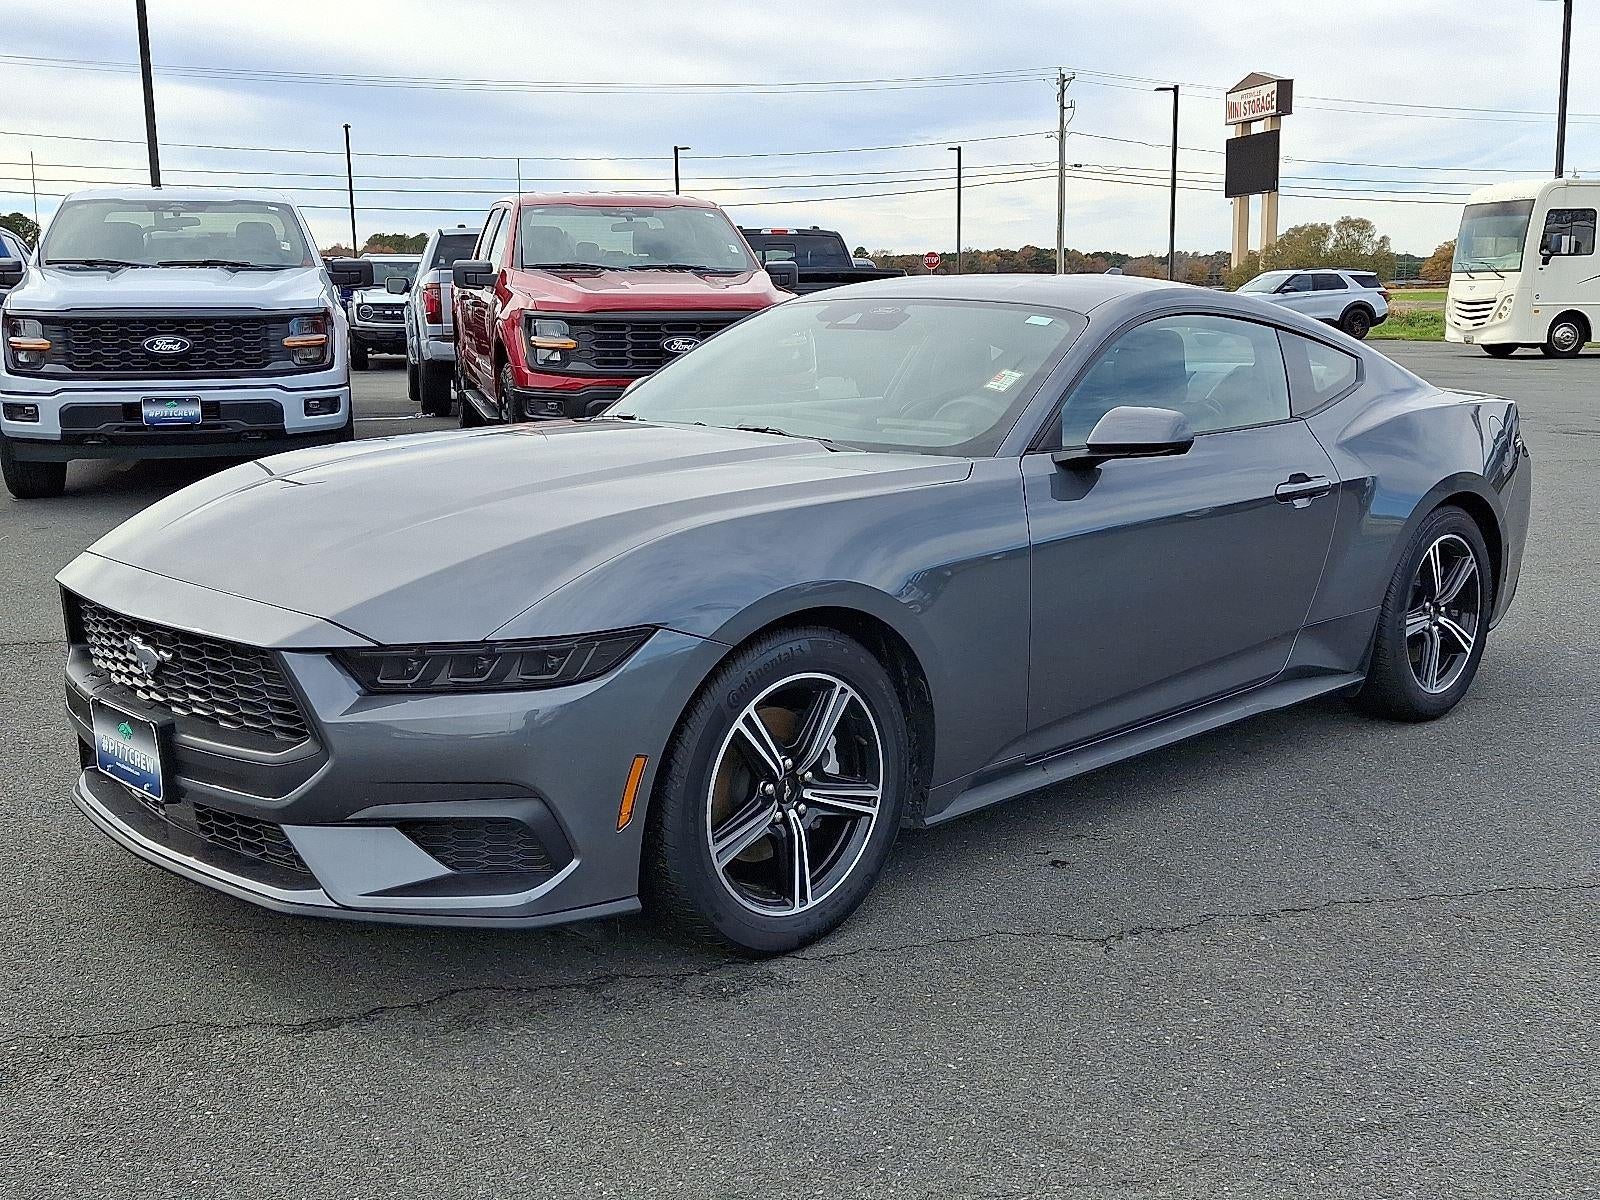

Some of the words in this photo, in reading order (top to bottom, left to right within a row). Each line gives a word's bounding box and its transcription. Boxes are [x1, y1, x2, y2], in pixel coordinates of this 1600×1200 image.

[1228, 100, 1242, 119] MINI
[1243, 90, 1275, 116] STORAGE
[924, 256, 939, 264] STOP
[153, 339, 182, 351] Ford
[671, 340, 696, 351] Ford
[148, 409, 196, 418] #PITTCREW
[101, 734, 154, 774] #PITTCREW
